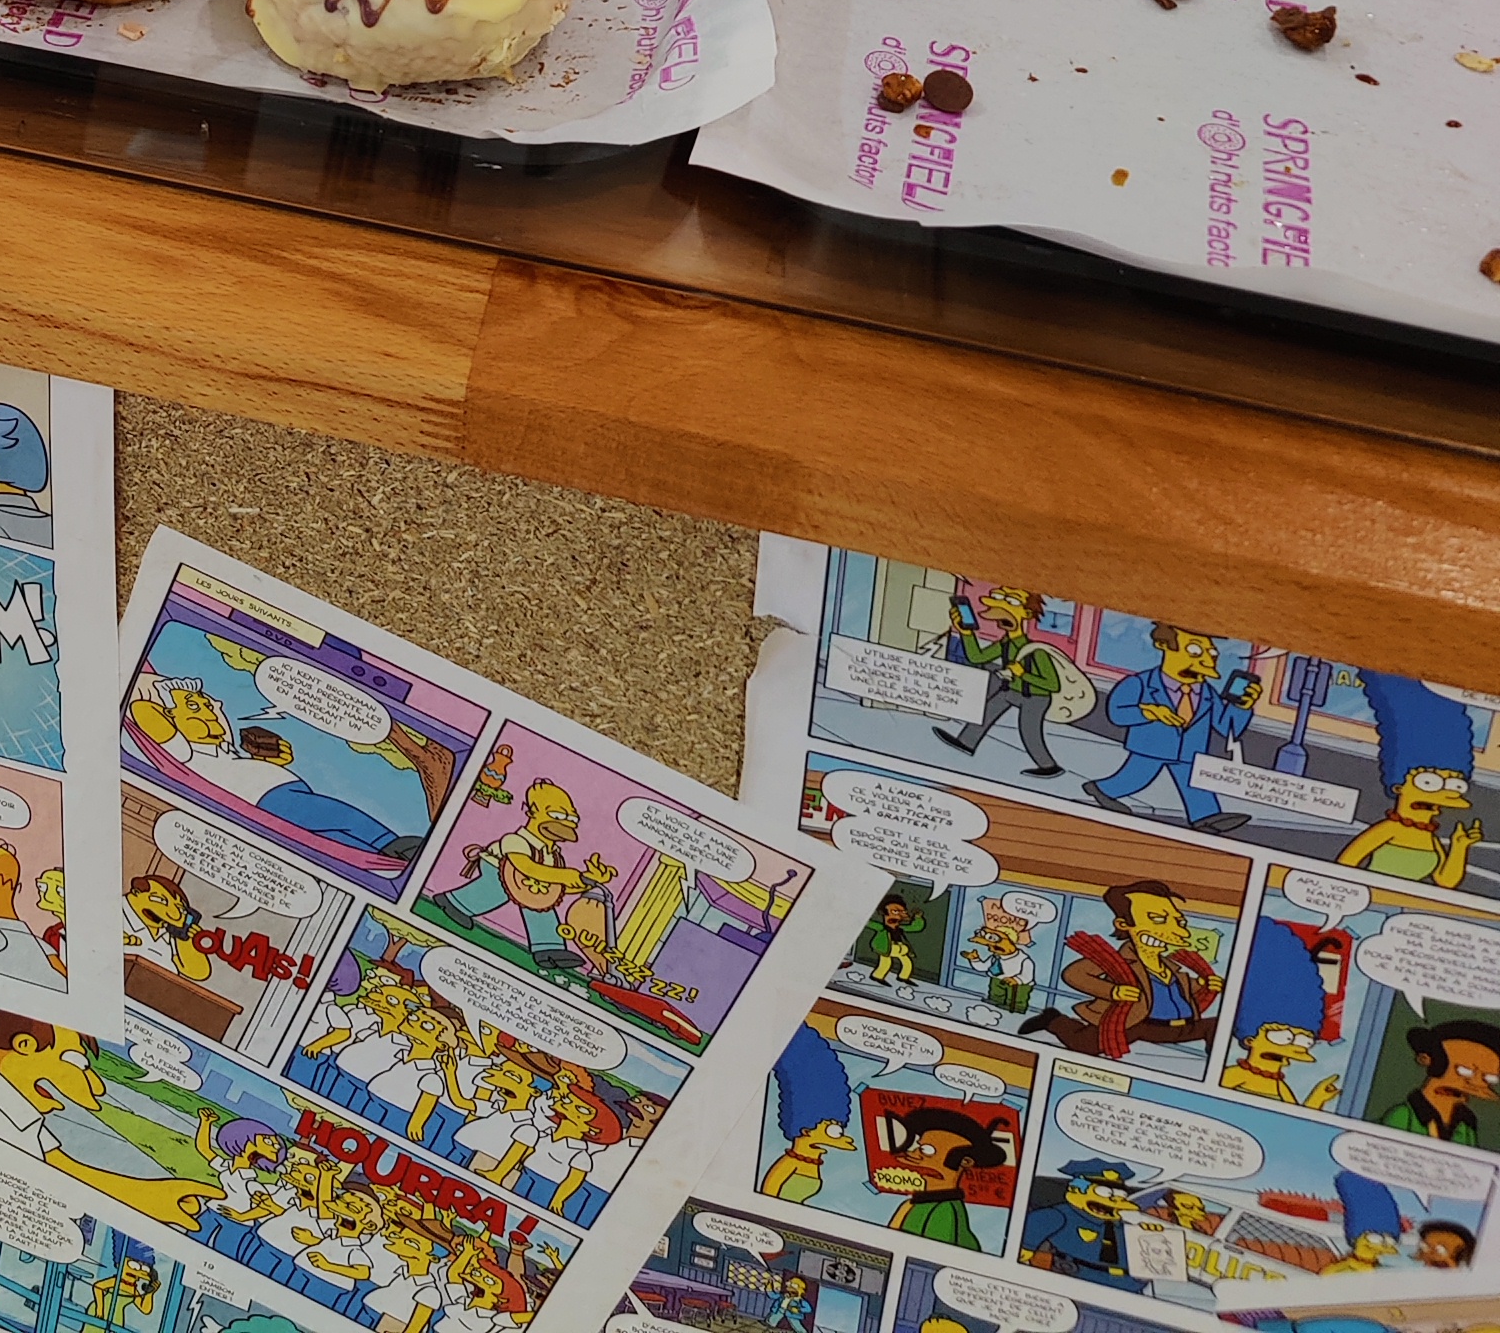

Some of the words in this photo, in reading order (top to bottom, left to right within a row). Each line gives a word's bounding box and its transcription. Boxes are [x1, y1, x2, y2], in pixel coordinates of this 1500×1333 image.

[1209, 174, 1238, 216] nuts
[194, 577, 212, 589] LES
[214, 588, 244, 605] JOURS
[854, 655, 867, 664] LE
[872, 659, 937, 682] LAVE-LINGE
[942, 676, 957, 686] DE
[863, 647, 902, 663] UTILISE
[267, 673, 294, 692] INFOS
[294, 687, 322, 704] DANS
[323, 700, 340, 712] UN
[342, 709, 377, 730] HAMAC
[268, 665, 285, 680] QUI
[284, 674, 313, 690] VOUS
[315, 687, 363, 715] PRÉSENTE
[364, 711, 382, 724] LES
[275, 686, 289, 696] EN
[291, 693, 345, 722] MANGEANT
[347, 719, 362, 732] UN
[280, 661, 293, 672] ICI
[295, 668, 322, 685] KENT
[324, 682, 377, 712] BROCKMAN
[293, 703, 332, 725] GÂTEAU
[636, 819, 685, 846] ANNONCE
[688, 843, 732, 870] SPÉCIALE
[641, 812, 679, 833] QUIMBY
[681, 832, 699, 844] QUI
[715, 847, 736, 863] UNE
[645, 804, 661, 815] ET
[664, 813, 690, 830] VOICI
[692, 828, 706, 839] LE
[708, 836, 739, 855] MAIRE
[669, 843, 698, 862] FAIRE
[192, 927, 315, 990] OUAIS!
[453, 957, 479, 974] DAVE
[481, 971, 526, 997] SHUTTON
[528, 994, 542, 1006] DU
[877, 1172, 923, 1189] PROMO
